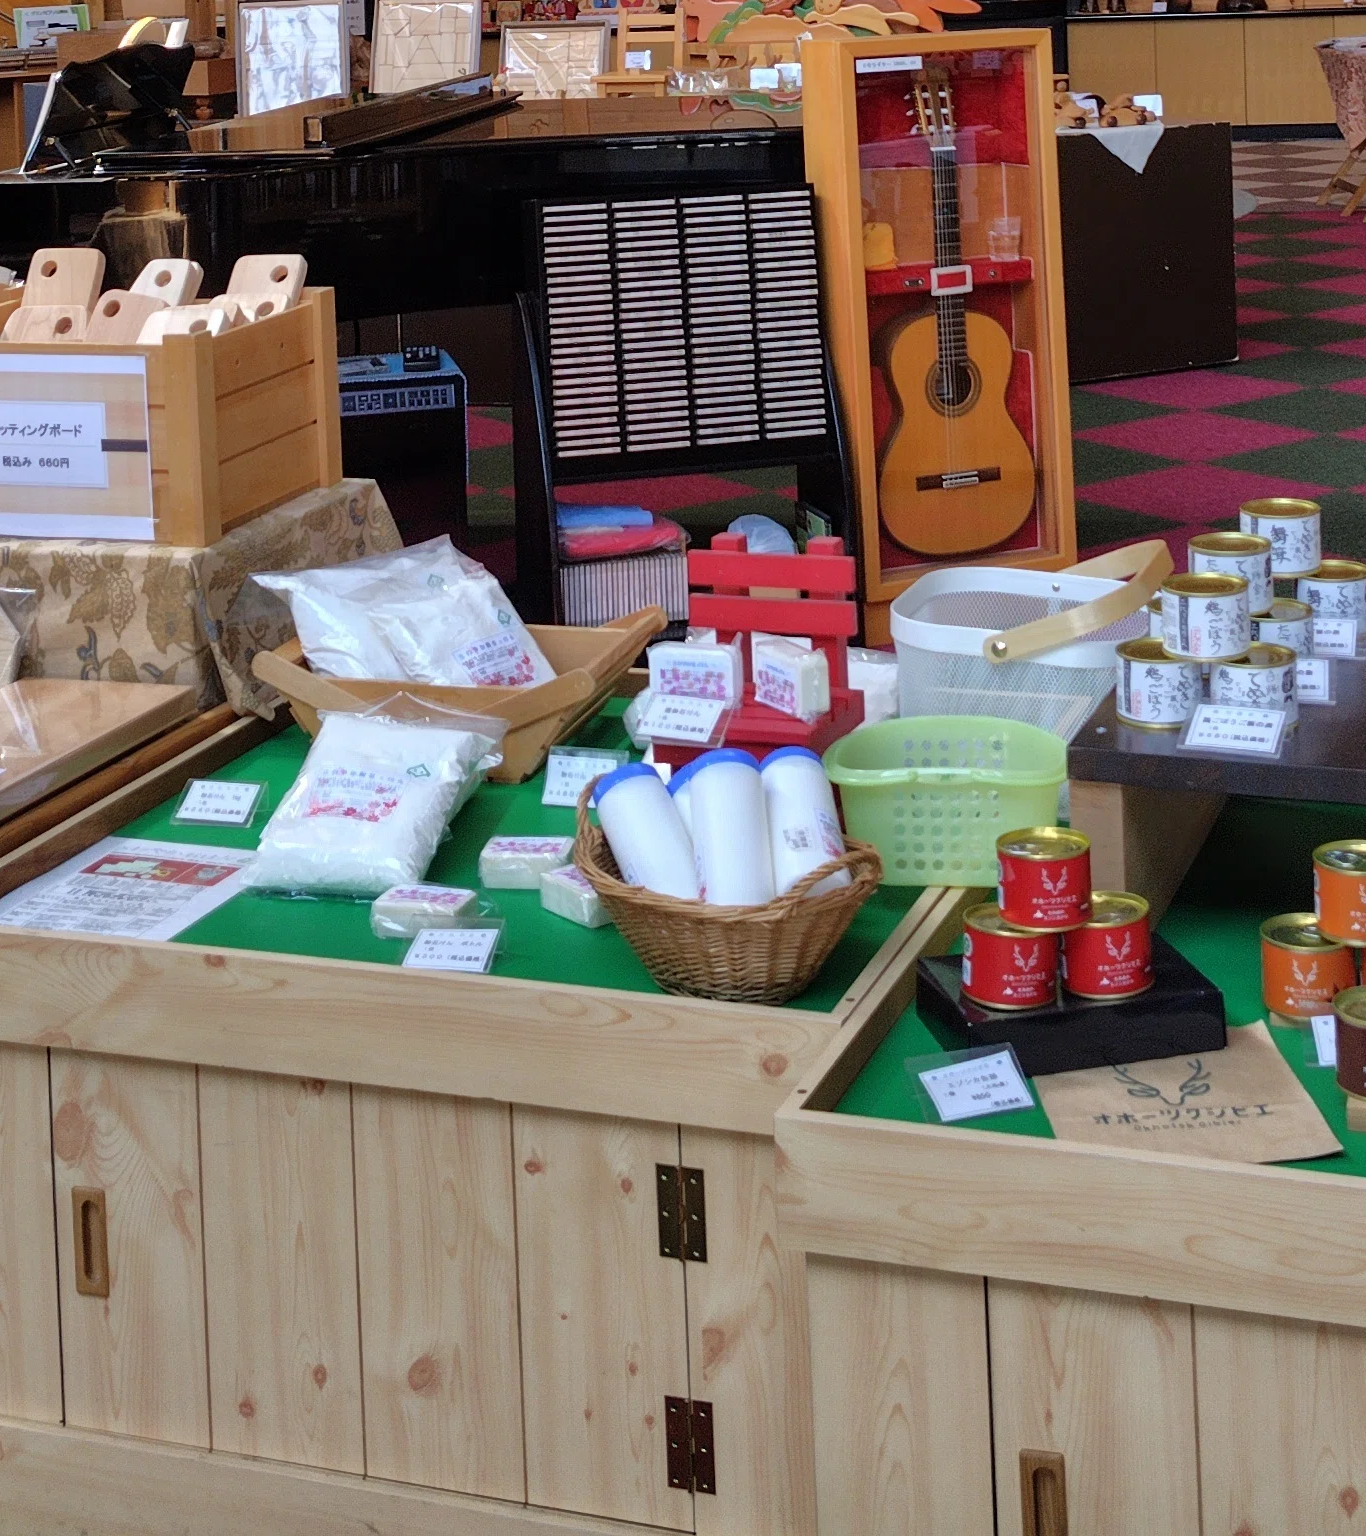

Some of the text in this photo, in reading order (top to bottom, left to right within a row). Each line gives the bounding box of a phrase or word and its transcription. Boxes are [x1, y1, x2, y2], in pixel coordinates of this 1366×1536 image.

[2, 455, 70, 469] 税込み 660円
[1090, 1103, 1275, 1126] オホーツクジビエ
